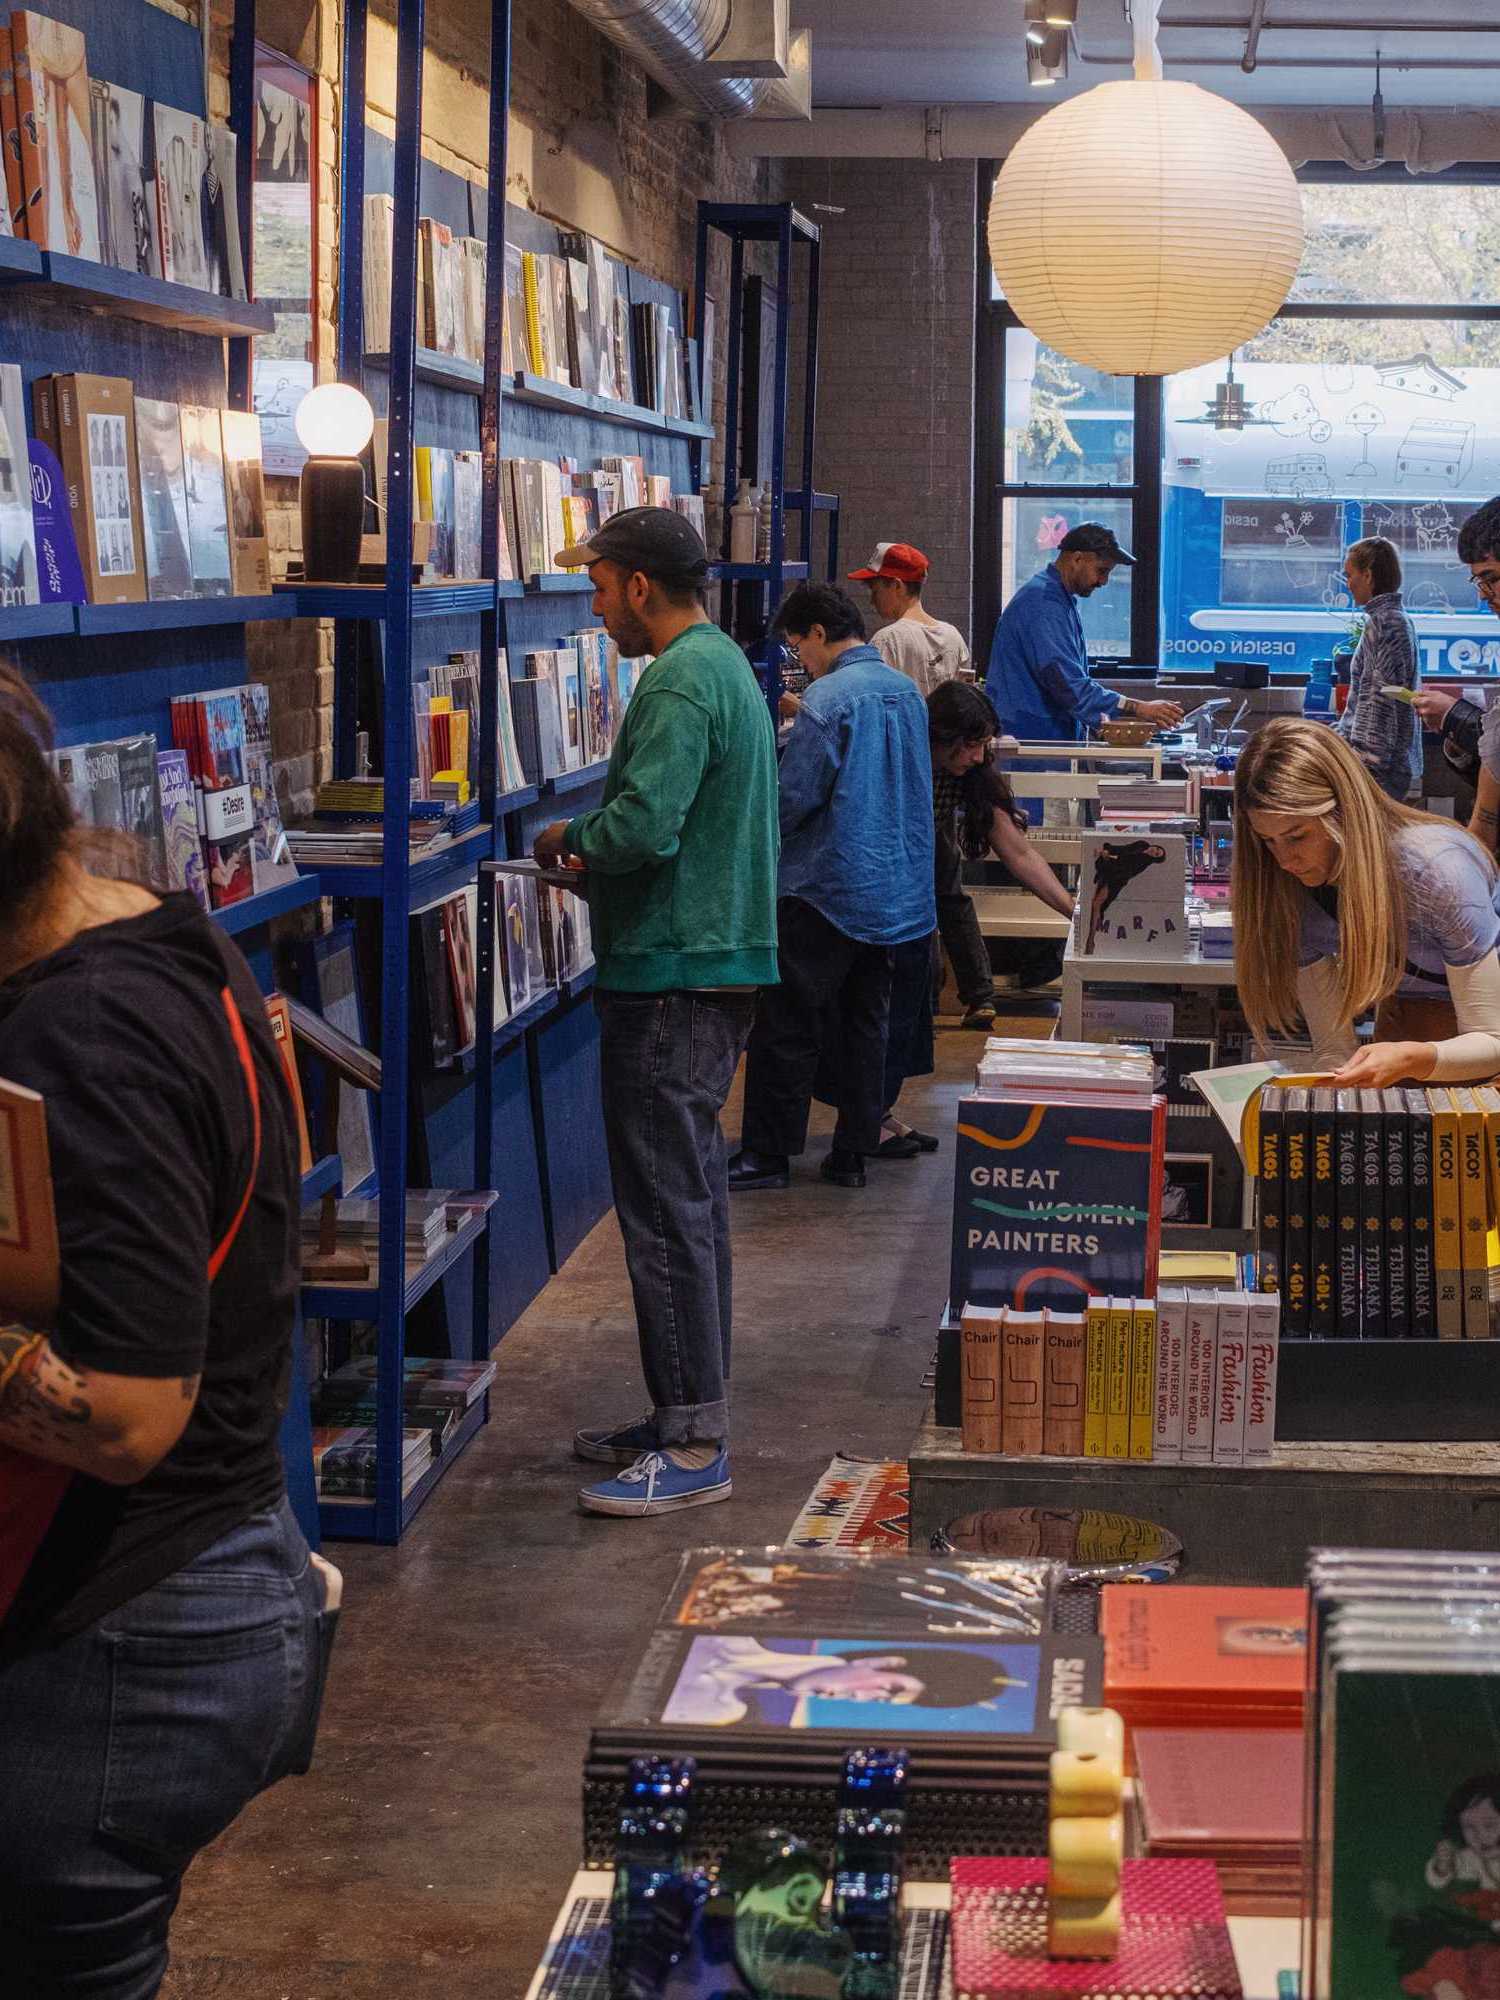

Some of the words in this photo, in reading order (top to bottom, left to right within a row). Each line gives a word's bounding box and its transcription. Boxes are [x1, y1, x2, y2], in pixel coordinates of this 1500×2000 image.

[68, 484, 78, 509] VOID
[1095, 915, 1176, 942] MARFA
[970, 1166, 1060, 1190] GREAT
[1264, 1133, 1278, 1180] TACOS
[1289, 1133, 1304, 1180] TACOS
[1316, 1133, 1331, 1181] TACOS
[1340, 1130, 1355, 1185] TACOS
[1364, 1130, 1379, 1186] TACOS
[1388, 1131, 1403, 1186] TACOS
[1413, 1131, 1428, 1186] TACOS
[1440, 1132, 1454, 1180] TACOS
[1465, 1133, 1480, 1180] TACOS
[1028, 1200, 1136, 1225] WOMEN
[967, 1228, 1099, 1255] PAINTERS
[964, 1331, 998, 1344] Chair
[1006, 1333, 1041, 1346] Chair
[1048, 1335, 1083, 1349] Chair
[1159, 1320, 1170, 1369] AROUND
[1171, 1338, 1181, 1357] 100
[1190, 1321, 1200, 1370] AROUND
[1202, 1339, 1212, 1359] 100
[1158, 1371, 1168, 1390] THE
[1169, 1358, 1181, 1417] INTERIORS
[1189, 1373, 1198, 1392] THE
[1200, 1361, 1211, 1418] INTERIORS
[1220, 1342, 1244, 1425] Fashion
[1250, 1343, 1274, 1426] Fashion
[1157, 1394, 1167, 1434] WORLD
[1187, 1396, 1198, 1435] WORLD
